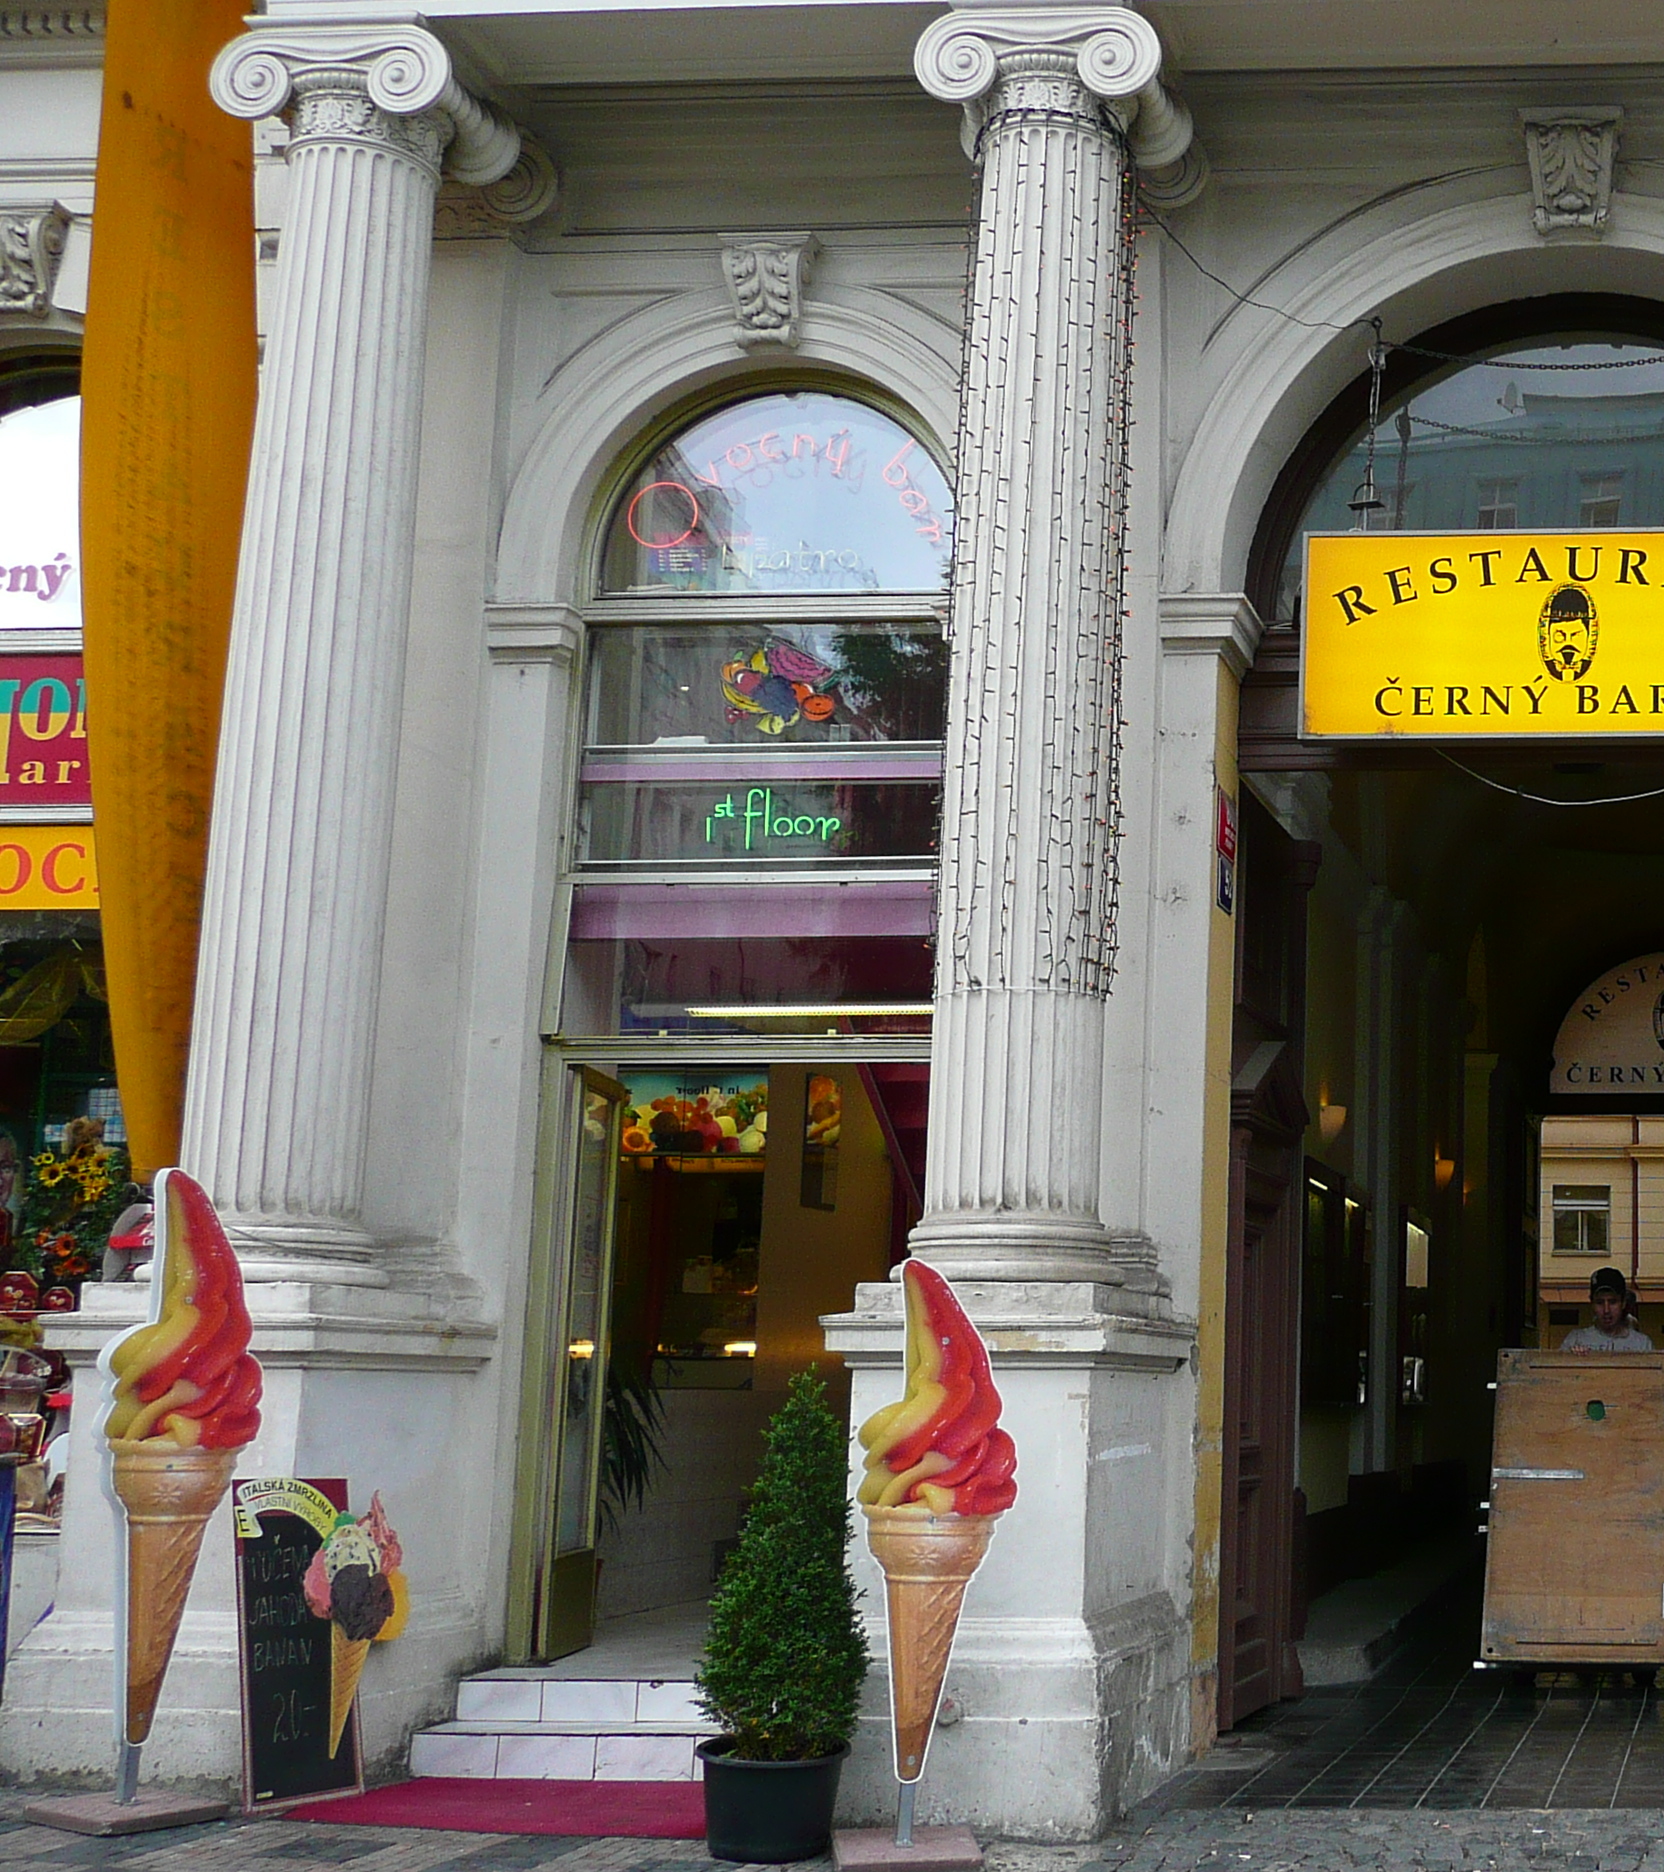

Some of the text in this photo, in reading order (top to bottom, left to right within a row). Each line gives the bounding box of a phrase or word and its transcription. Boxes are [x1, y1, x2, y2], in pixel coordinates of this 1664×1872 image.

[882, 438, 942, 543] bar
[1374, 675, 1550, 717] ČERNÝ
[743, 787, 841, 850] floor
[243, 1479, 332, 1519] ITALSKÁ ZMRZLINA
